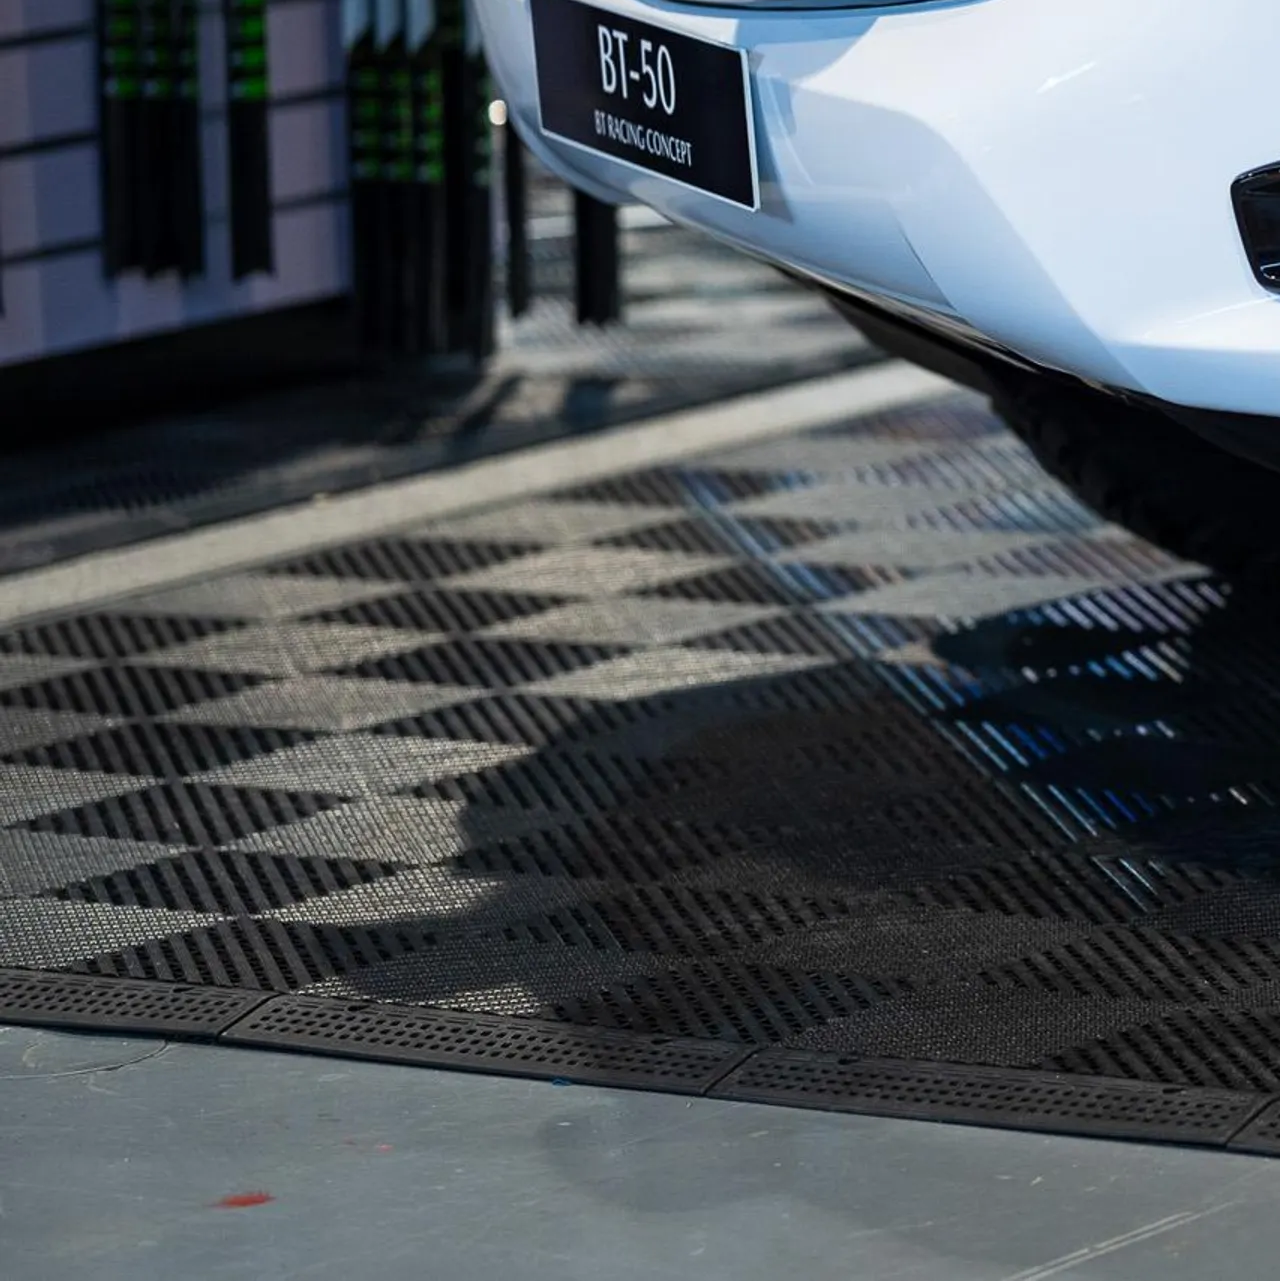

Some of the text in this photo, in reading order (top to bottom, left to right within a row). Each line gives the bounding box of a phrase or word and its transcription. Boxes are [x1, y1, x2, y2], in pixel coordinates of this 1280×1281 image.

[598, 25, 676, 116] BT-50
[594, 109, 692, 167] BT RACING CONCEPT
